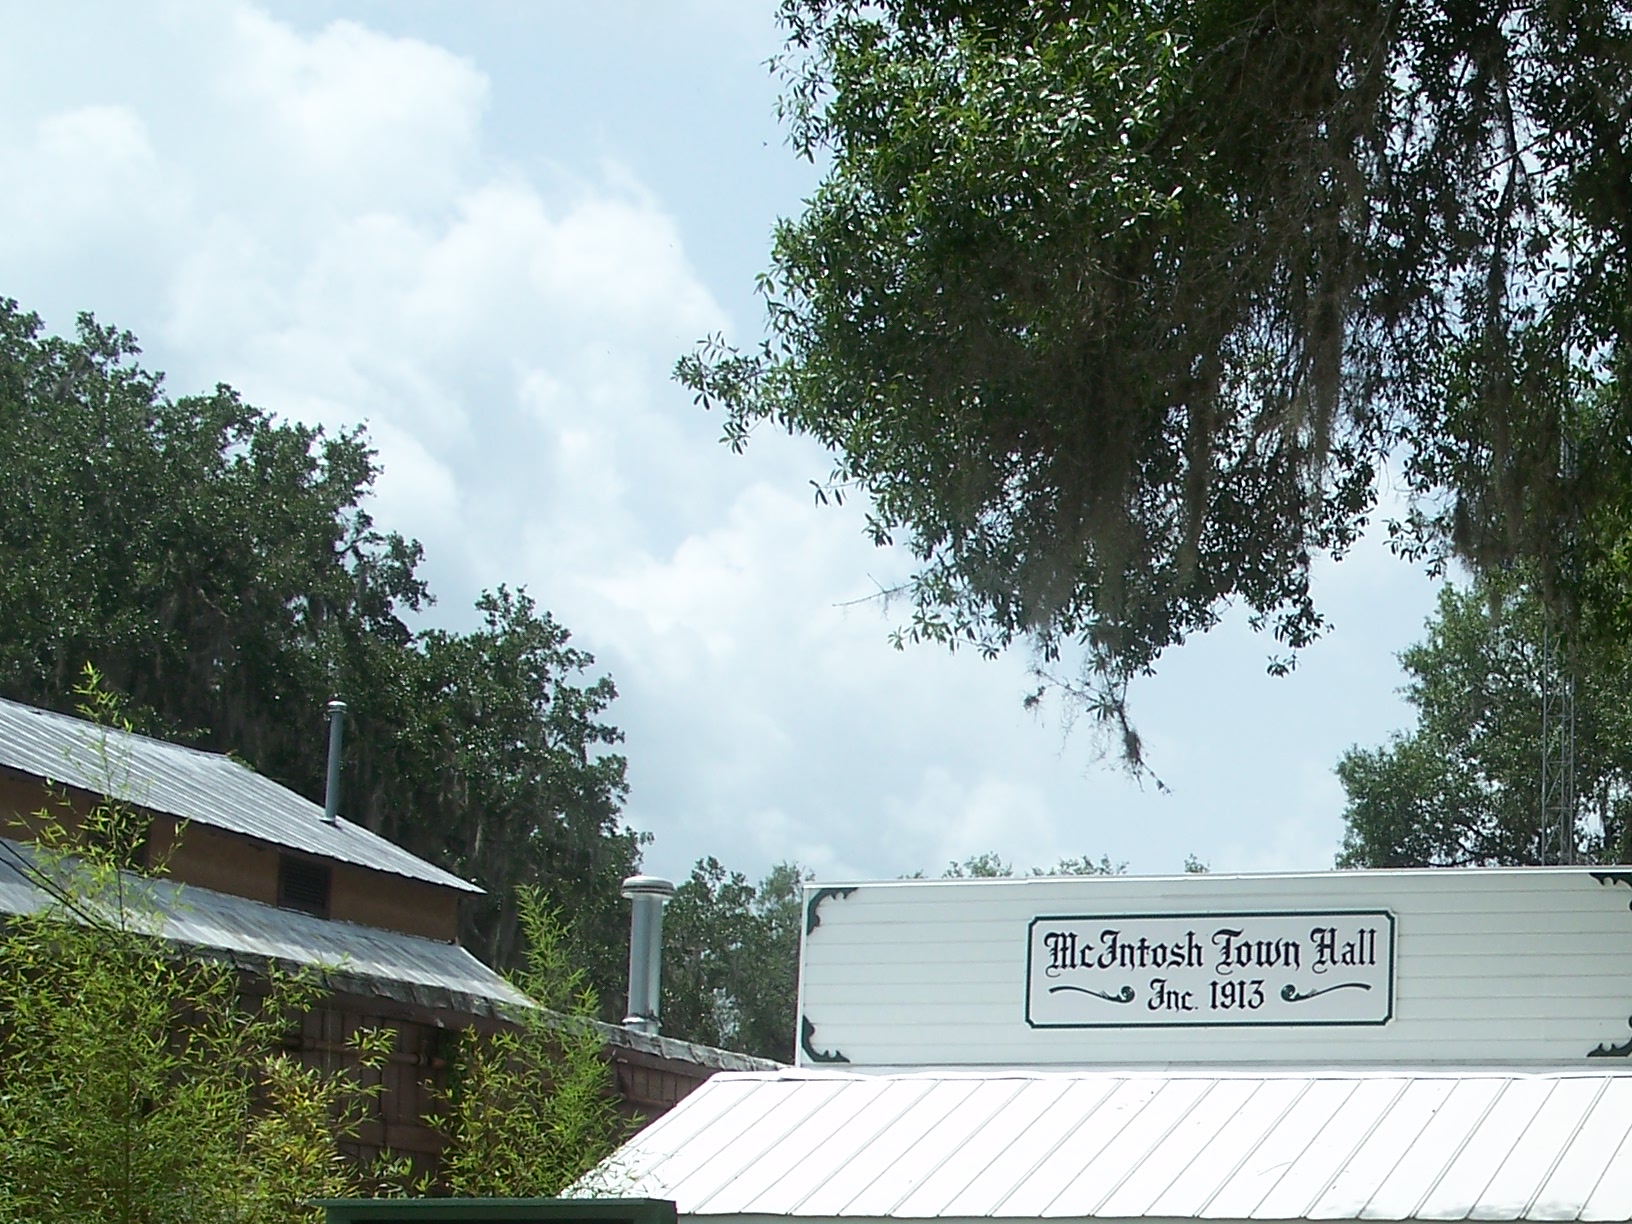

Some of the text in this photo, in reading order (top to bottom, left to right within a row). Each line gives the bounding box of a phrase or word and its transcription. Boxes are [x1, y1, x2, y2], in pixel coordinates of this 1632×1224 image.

[1043, 927, 1377, 977] McIntosh Town Hall
[1147, 978, 1265, 1013] Inc. 1913
